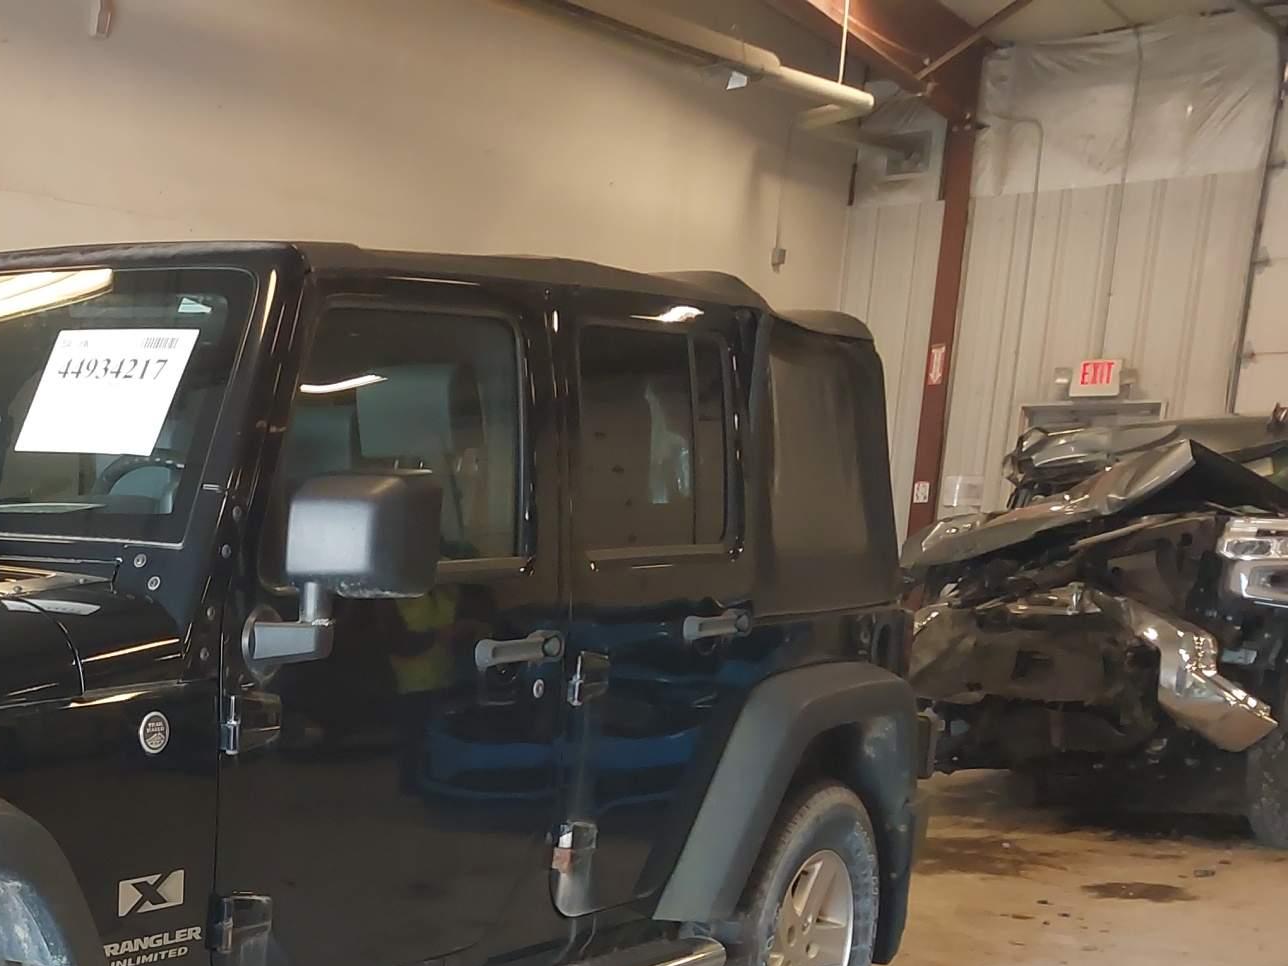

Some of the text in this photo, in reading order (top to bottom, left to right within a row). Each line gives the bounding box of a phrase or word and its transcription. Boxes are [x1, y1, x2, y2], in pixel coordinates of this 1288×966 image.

[58, 358, 168, 380] 44934217
[1081, 362, 1114, 385] EXIT
[103, 926, 202, 957] RANGLER
